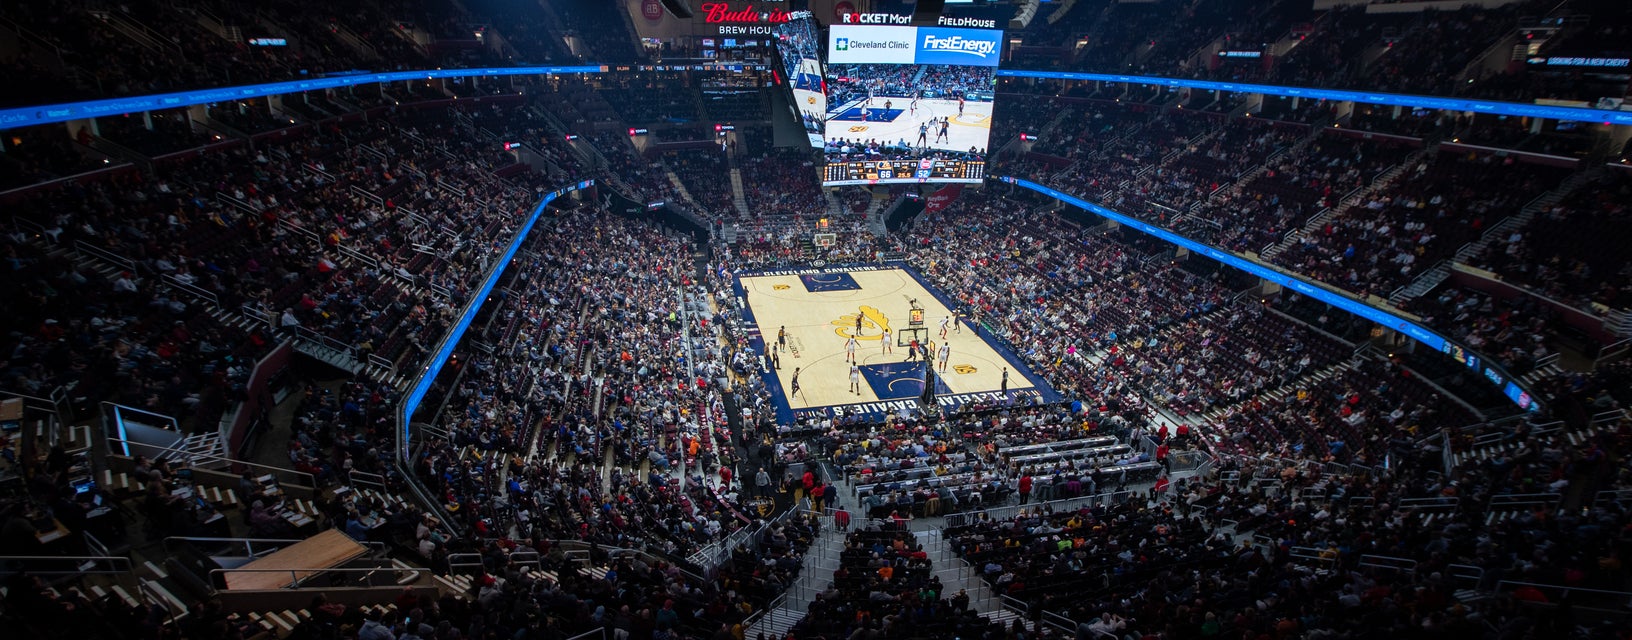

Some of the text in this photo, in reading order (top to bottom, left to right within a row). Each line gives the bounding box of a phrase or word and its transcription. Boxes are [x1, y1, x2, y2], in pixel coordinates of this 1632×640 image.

[842, 13, 912, 24] ROCKET Mort
[719, 26, 746, 34] BREW
[850, 40, 910, 49] Cleveland Clinic
[923, 35, 994, 54] FirstEnergy
[832, 400, 917, 416] CAVALIES
